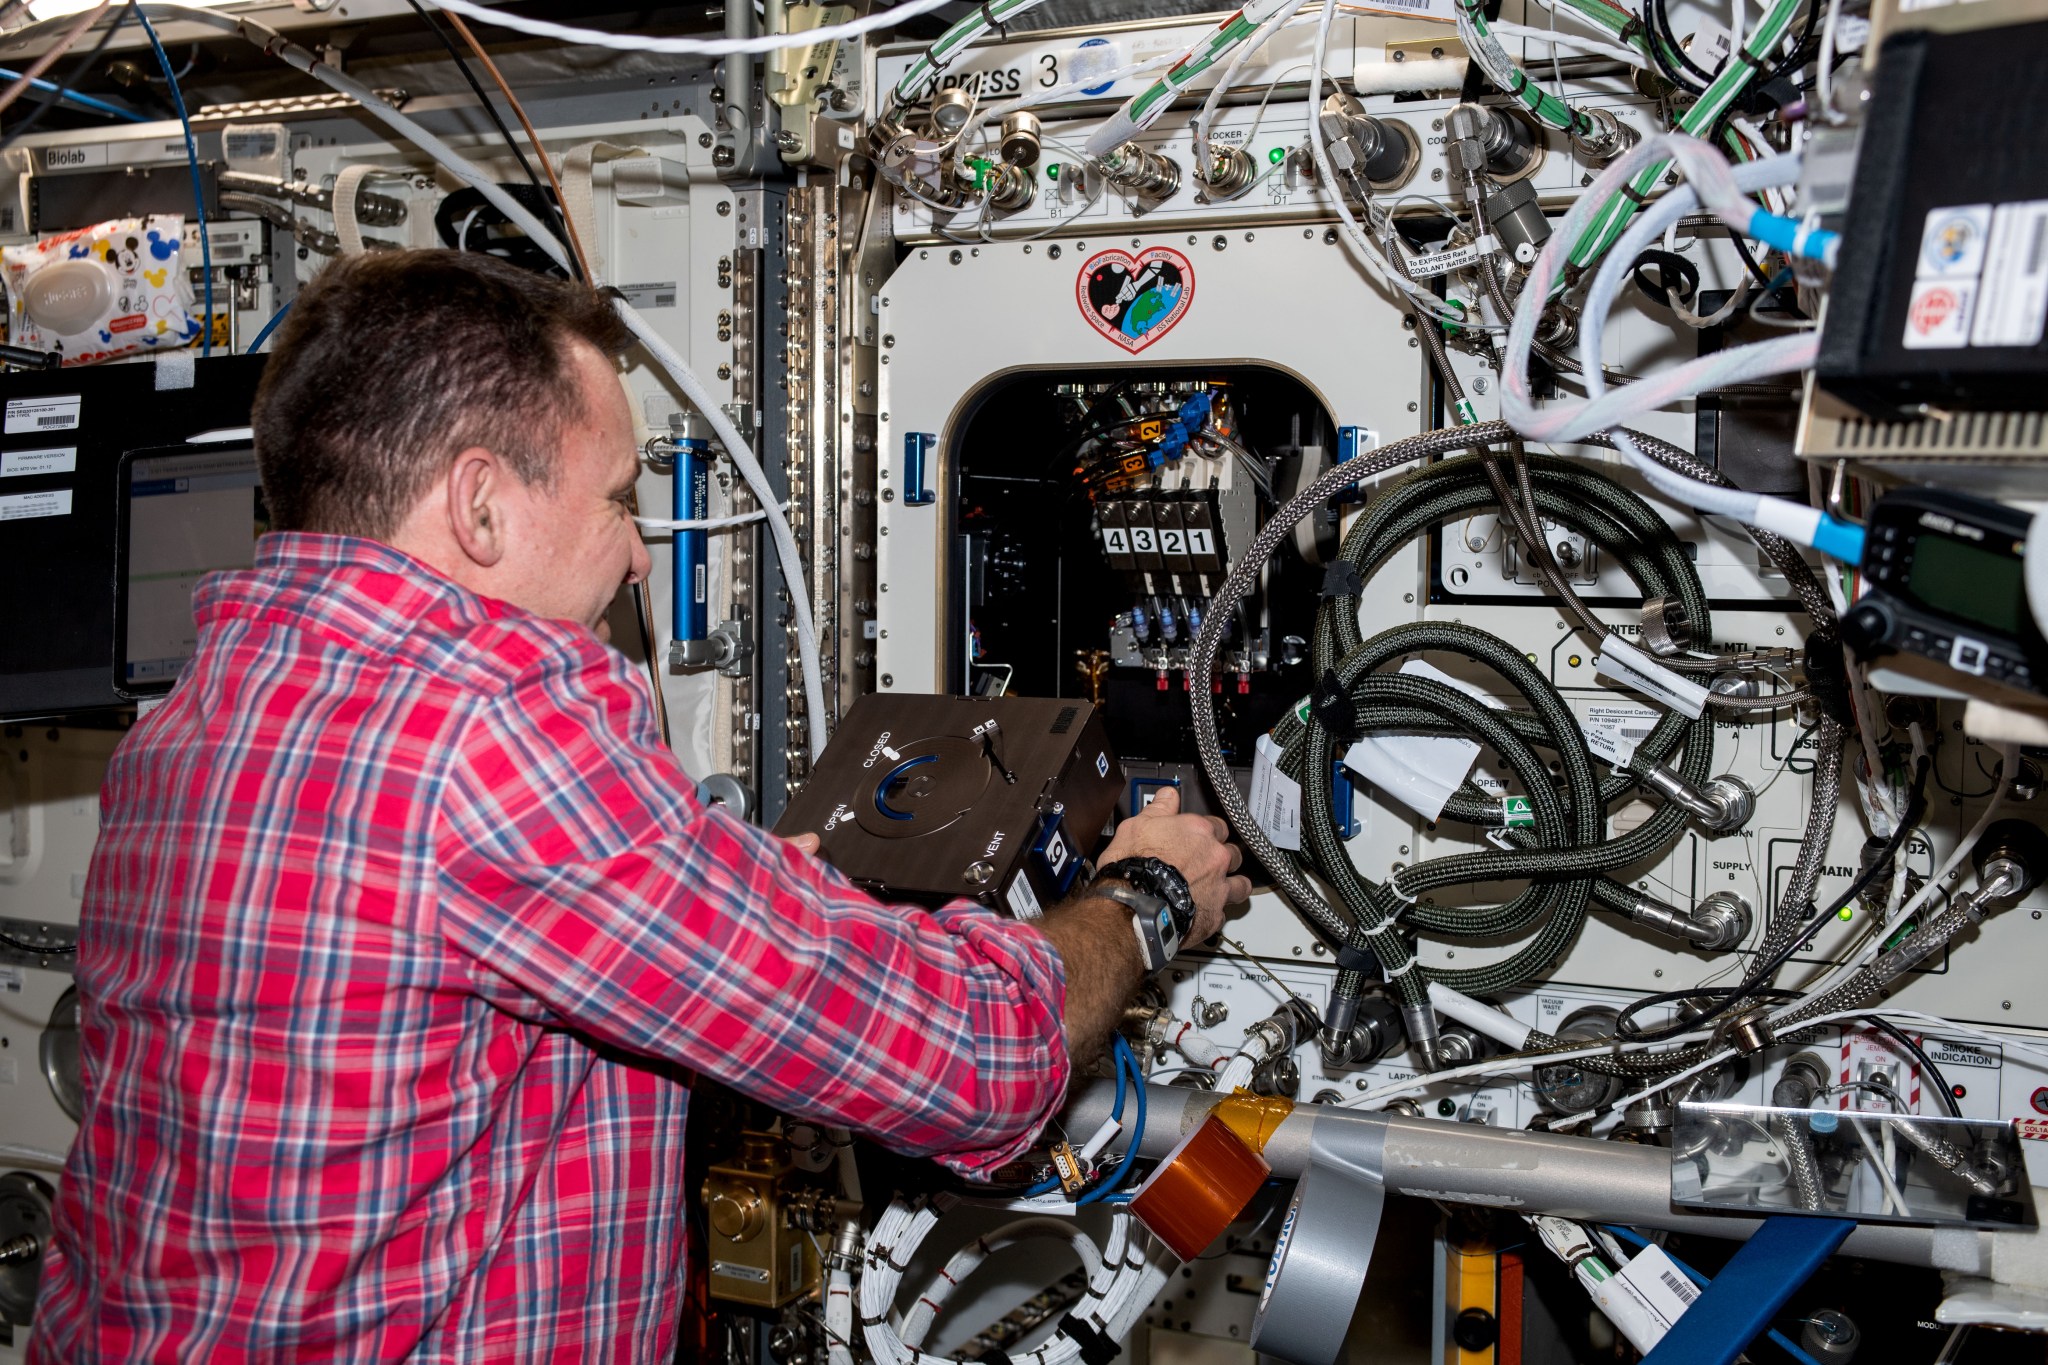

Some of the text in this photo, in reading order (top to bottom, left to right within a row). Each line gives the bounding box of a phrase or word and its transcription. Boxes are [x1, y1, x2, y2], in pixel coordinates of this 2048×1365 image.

[904, 54, 1058, 98] XPRESS 3
[1208, 131, 1243, 140] LOCKER
[49, 149, 85, 165] Biolab
[1273, 195, 1287, 206] D1
[1050, 209, 1063, 218] B1
[1088, 254, 1132, 270] BioFabrication
[1150, 252, 1173, 260] Facility
[1418, 254, 1452, 266] EXPRESS
[1452, 249, 1468, 258] Rack
[1410, 263, 1445, 275] COOLANT
[1445, 258, 1467, 268] WATER
[1081, 285, 1105, 328] Redwire Space
[1157, 286, 1190, 332] ISS National Lab
[1117, 334, 1134, 347] NASA
[1143, 424, 1159, 436] 2
[1125, 458, 1143, 469] 3
[1109, 530, 1207, 553] 4 3 2 1
[1567, 535, 1578, 543] ON
[1589, 707, 1605, 715] Right
[1716, 720, 1755, 730] SUPPLY
[1590, 732, 1615, 746] Payload
[1732, 731, 1739, 740] A
[863, 731, 891, 768] CLOSED
[1590, 738, 1616, 754] RETURN
[1477, 778, 1504, 788] OPEN
[1517, 802, 1523, 810] 0
[824, 804, 848, 831] OPEN
[983, 830, 1006, 858] VENT
[1909, 844, 1927, 854] J2
[1712, 861, 1752, 871] SUPPLY
[1728, 872, 1736, 881] B
[1240, 973, 1273, 983] LAPTOP
[1942, 1043, 1982, 1055] SMOKE
[1930, 1052, 1993, 1065] INDICATION
